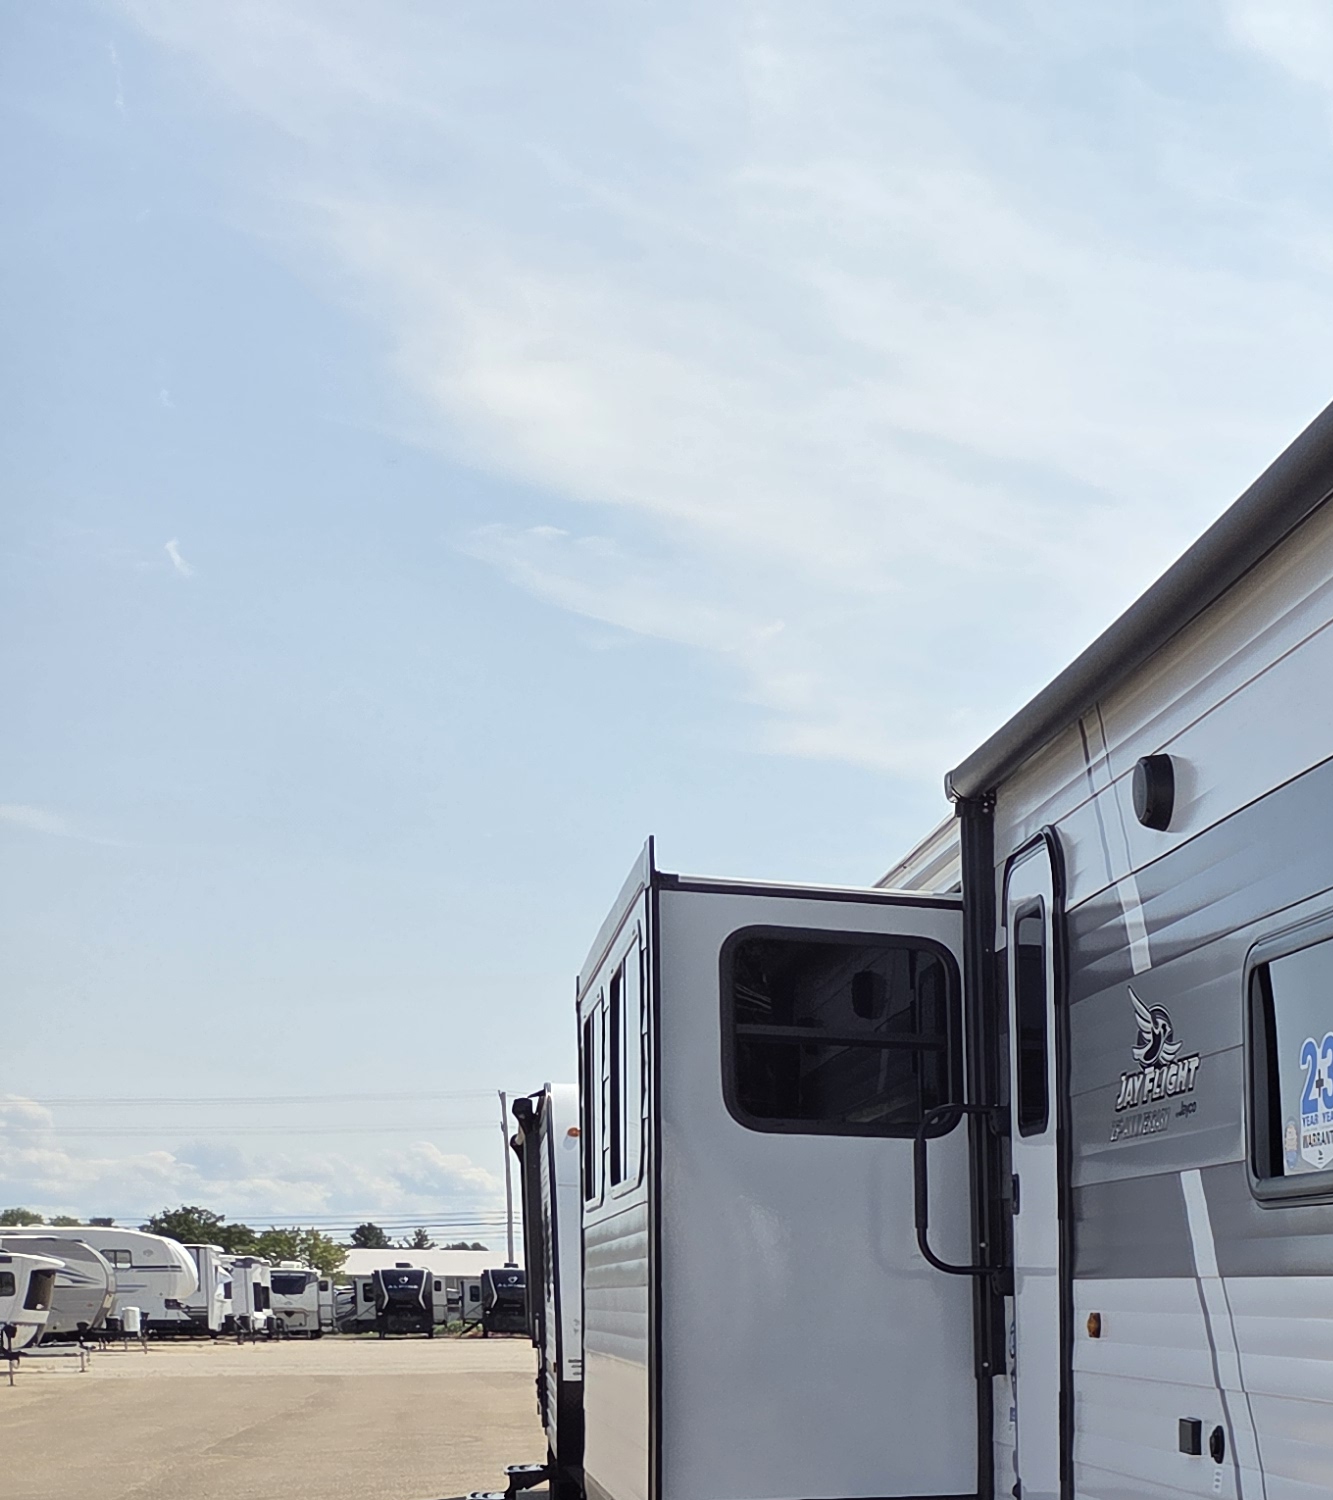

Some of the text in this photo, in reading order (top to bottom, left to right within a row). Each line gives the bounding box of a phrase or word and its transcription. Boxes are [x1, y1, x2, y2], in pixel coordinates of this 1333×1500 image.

[1115, 1053, 1200, 1112] JAY FLIGHT
[1302, 1113, 1319, 1128] YEAR
